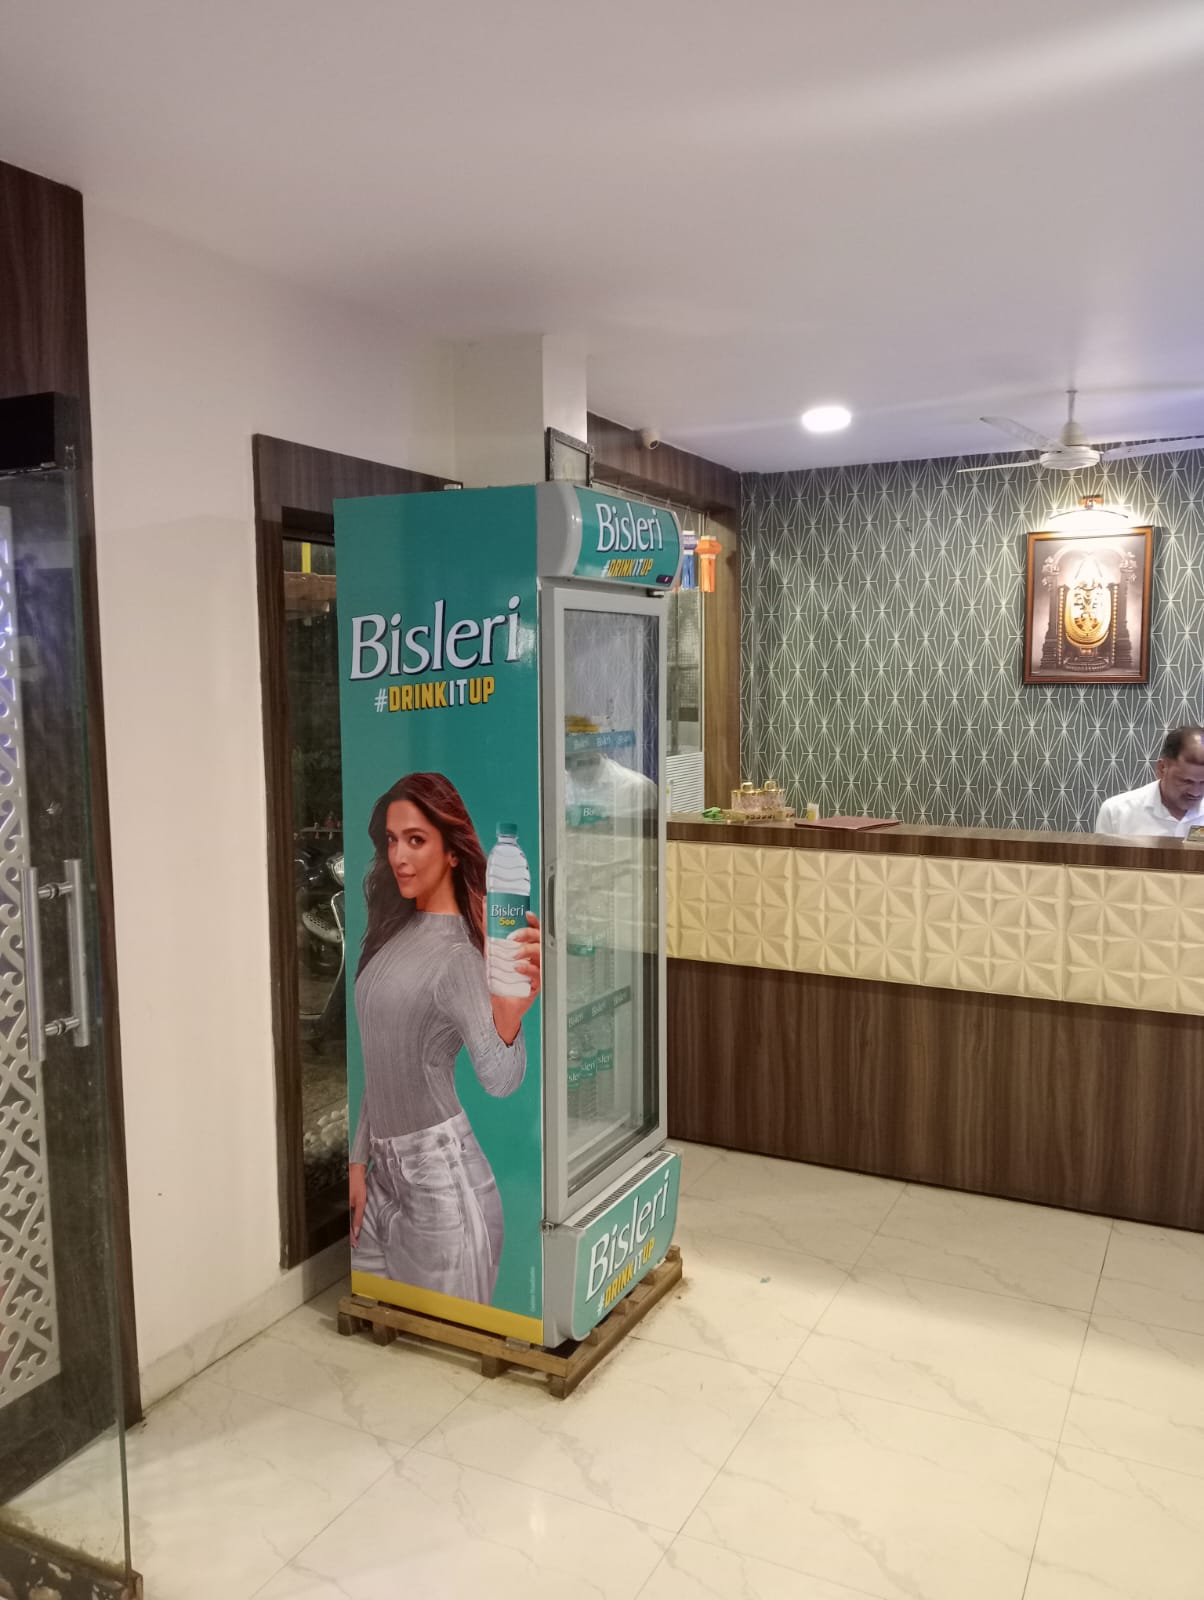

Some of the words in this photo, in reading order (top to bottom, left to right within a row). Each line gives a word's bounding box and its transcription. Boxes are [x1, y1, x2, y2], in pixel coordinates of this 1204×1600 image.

[596, 502, 663, 552] Bisleri
[601, 558, 654, 578] #DRINKITUP
[349, 595, 521, 681] Bisleri
[374, 676, 495, 713] #DRINKITUP
[491, 903, 524, 917] Bisleri
[585, 1168, 670, 1304] Bisleri
[597, 1237, 655, 1316] #DRINKITUP
